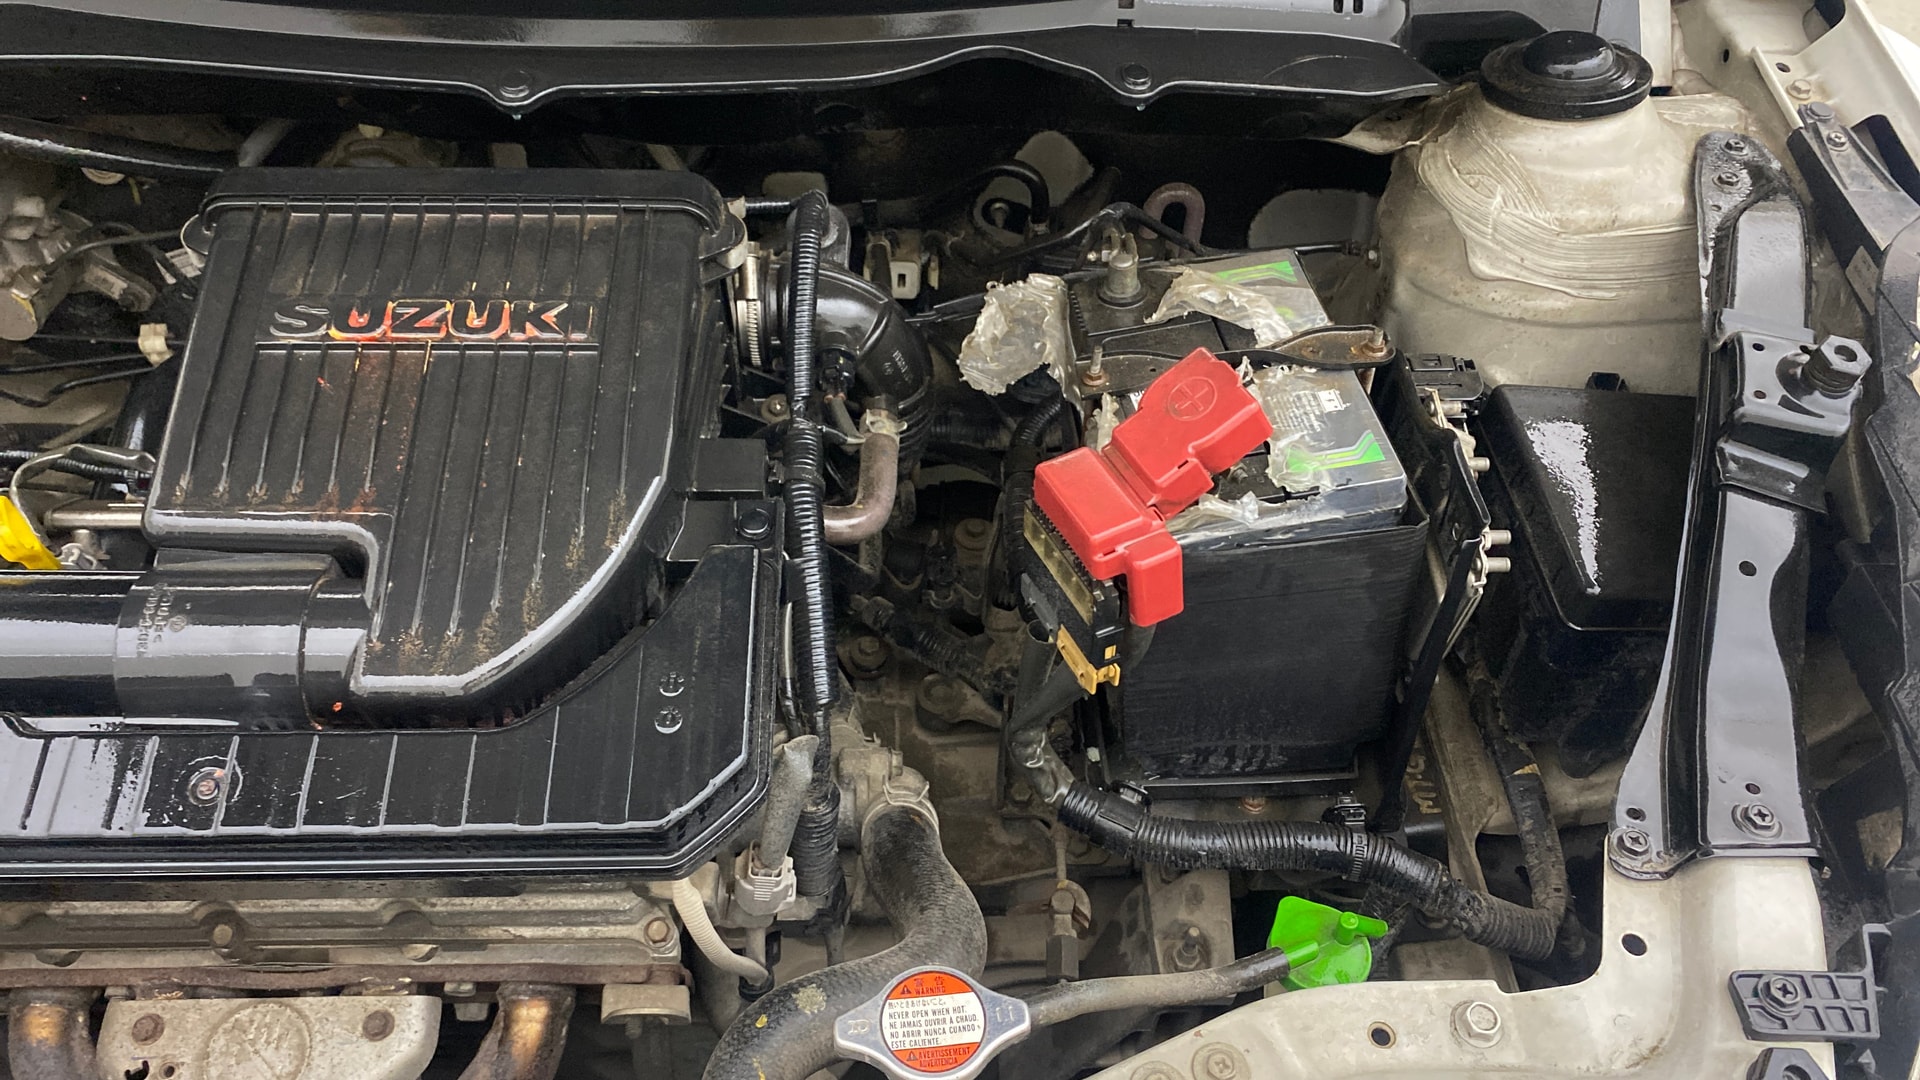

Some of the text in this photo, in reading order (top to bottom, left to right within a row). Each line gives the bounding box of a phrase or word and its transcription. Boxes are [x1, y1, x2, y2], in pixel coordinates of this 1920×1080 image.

[270, 299, 594, 341] SUZUKI
[914, 986, 946, 996] WARNING
[889, 1011, 910, 1020] NEVER
[911, 1009, 929, 1018] OPEN
[931, 1007, 950, 1017] WHEN
[889, 1021, 898, 1030] NE
[900, 1019, 923, 1029] JAMAIS
[924, 1017, 947, 1027] OUVRIR
[890, 1023, 976, 1039] NO ABRIR NUNCA CUANDO
[891, 1040, 907, 1049] ESTE
[918, 1046, 971, 1060] AVERTISSEMENT
[920, 1057, 958, 1068] ADVERTENCIA
